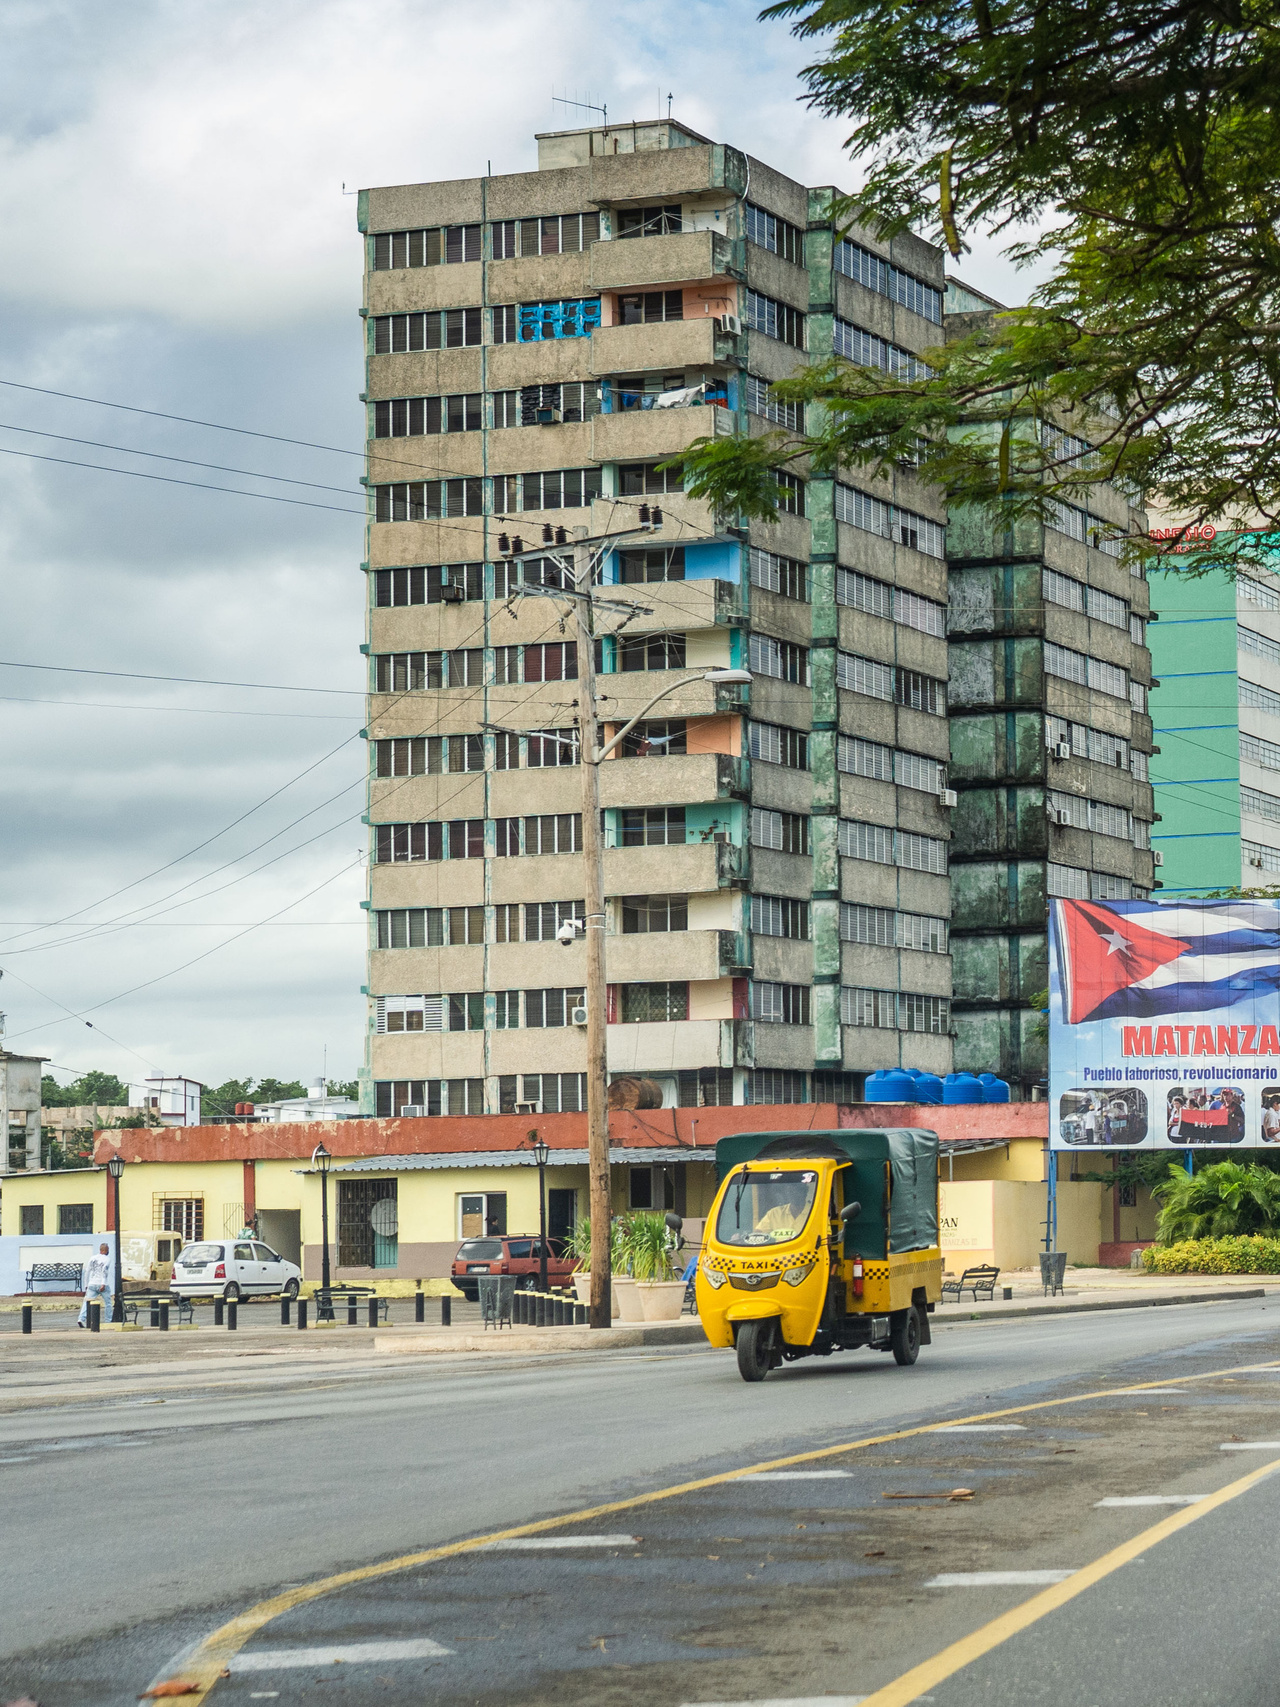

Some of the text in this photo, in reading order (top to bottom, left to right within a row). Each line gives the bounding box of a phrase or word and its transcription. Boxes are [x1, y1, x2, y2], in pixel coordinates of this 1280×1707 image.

[1083, 1067, 1122, 1081] Pueblo
[1125, 1066, 1182, 1082] laborioso,
[1183, 1066, 1277, 1080] revolucionario
[741, 1261, 768, 1270] TAXI
